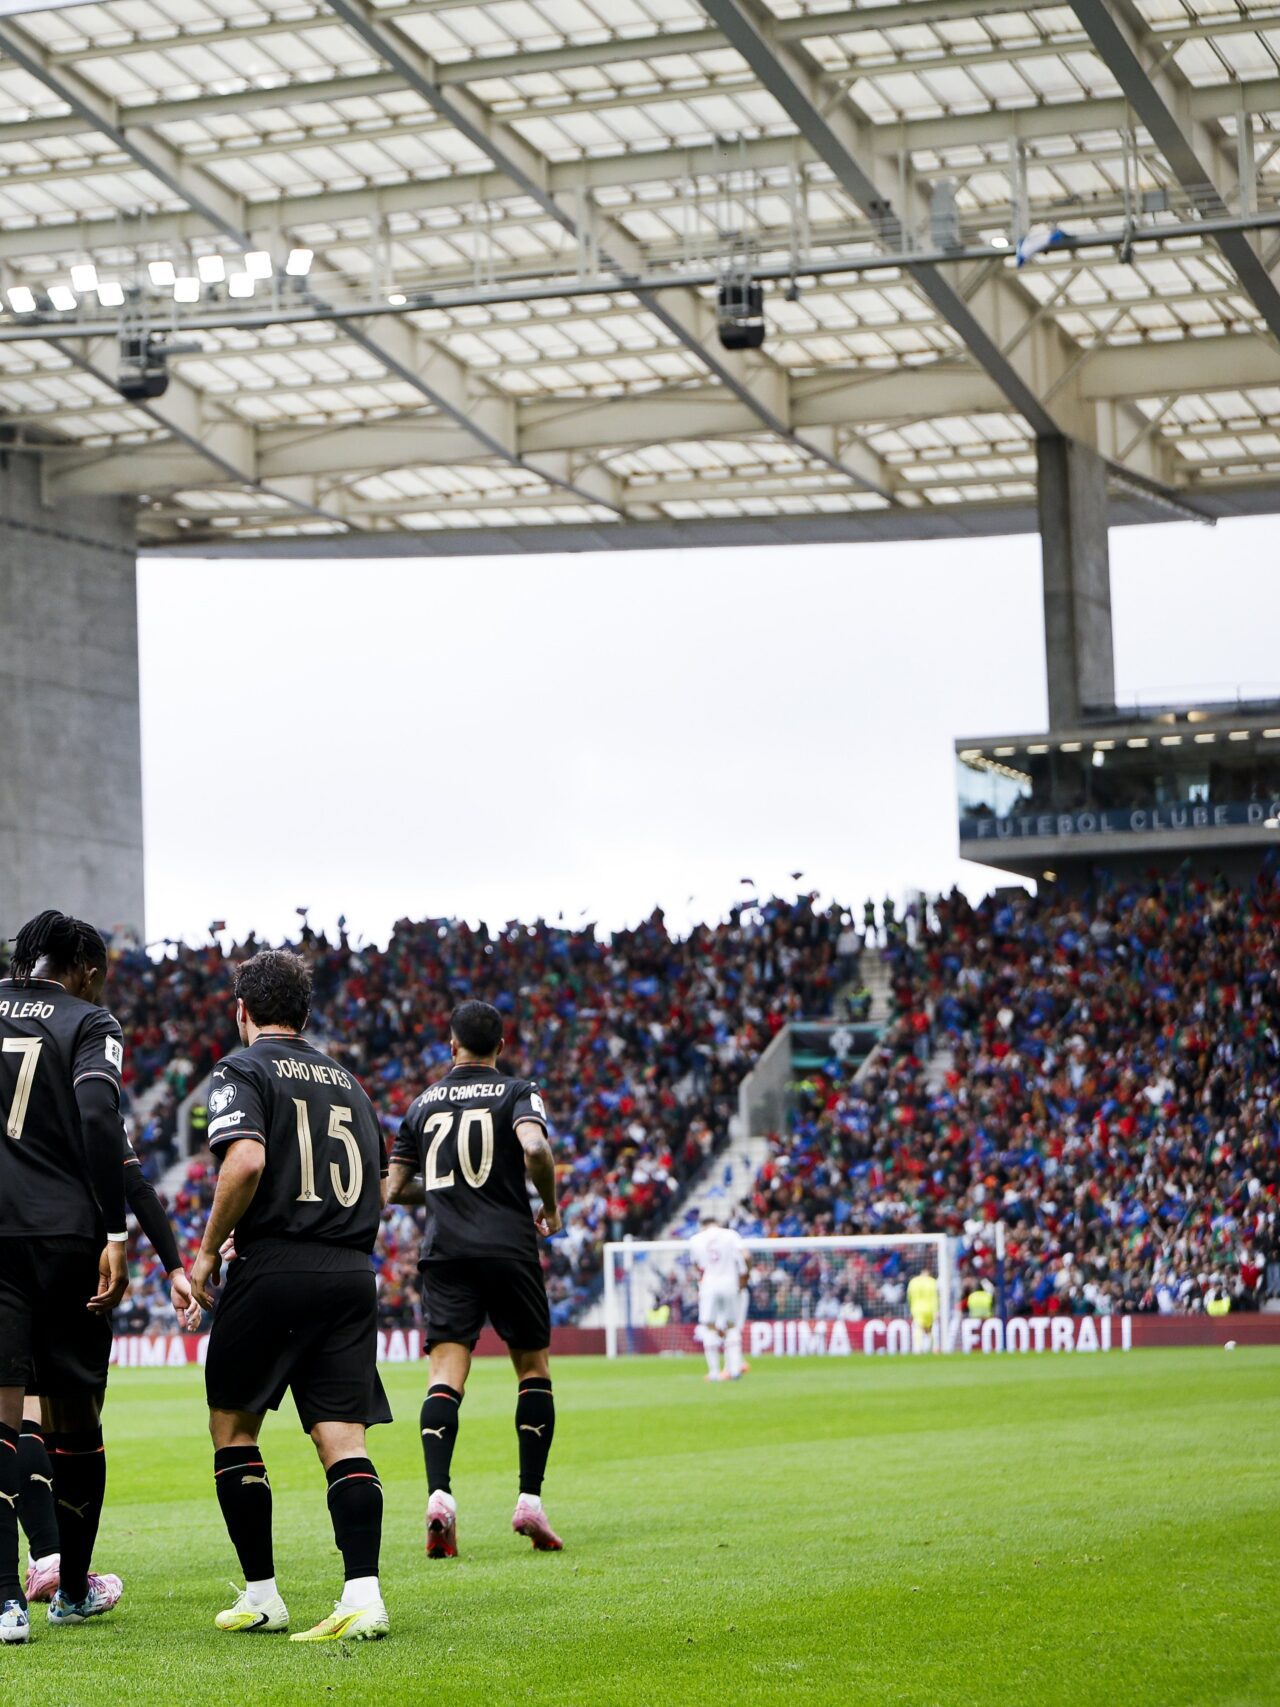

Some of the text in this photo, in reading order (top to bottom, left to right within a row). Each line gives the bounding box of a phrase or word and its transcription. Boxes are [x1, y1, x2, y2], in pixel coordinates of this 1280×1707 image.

[976, 812, 1114, 838] FUTEBOL
[1129, 804, 1229, 832] CLUBE
[10, 1001, 55, 1019] LEÃO
[272, 1057, 352, 1090] JOÃO NEVES
[449, 1083, 505, 1101] CANCELO
[291, 1097, 363, 1208] 15
[423, 1108, 494, 1191] 20
